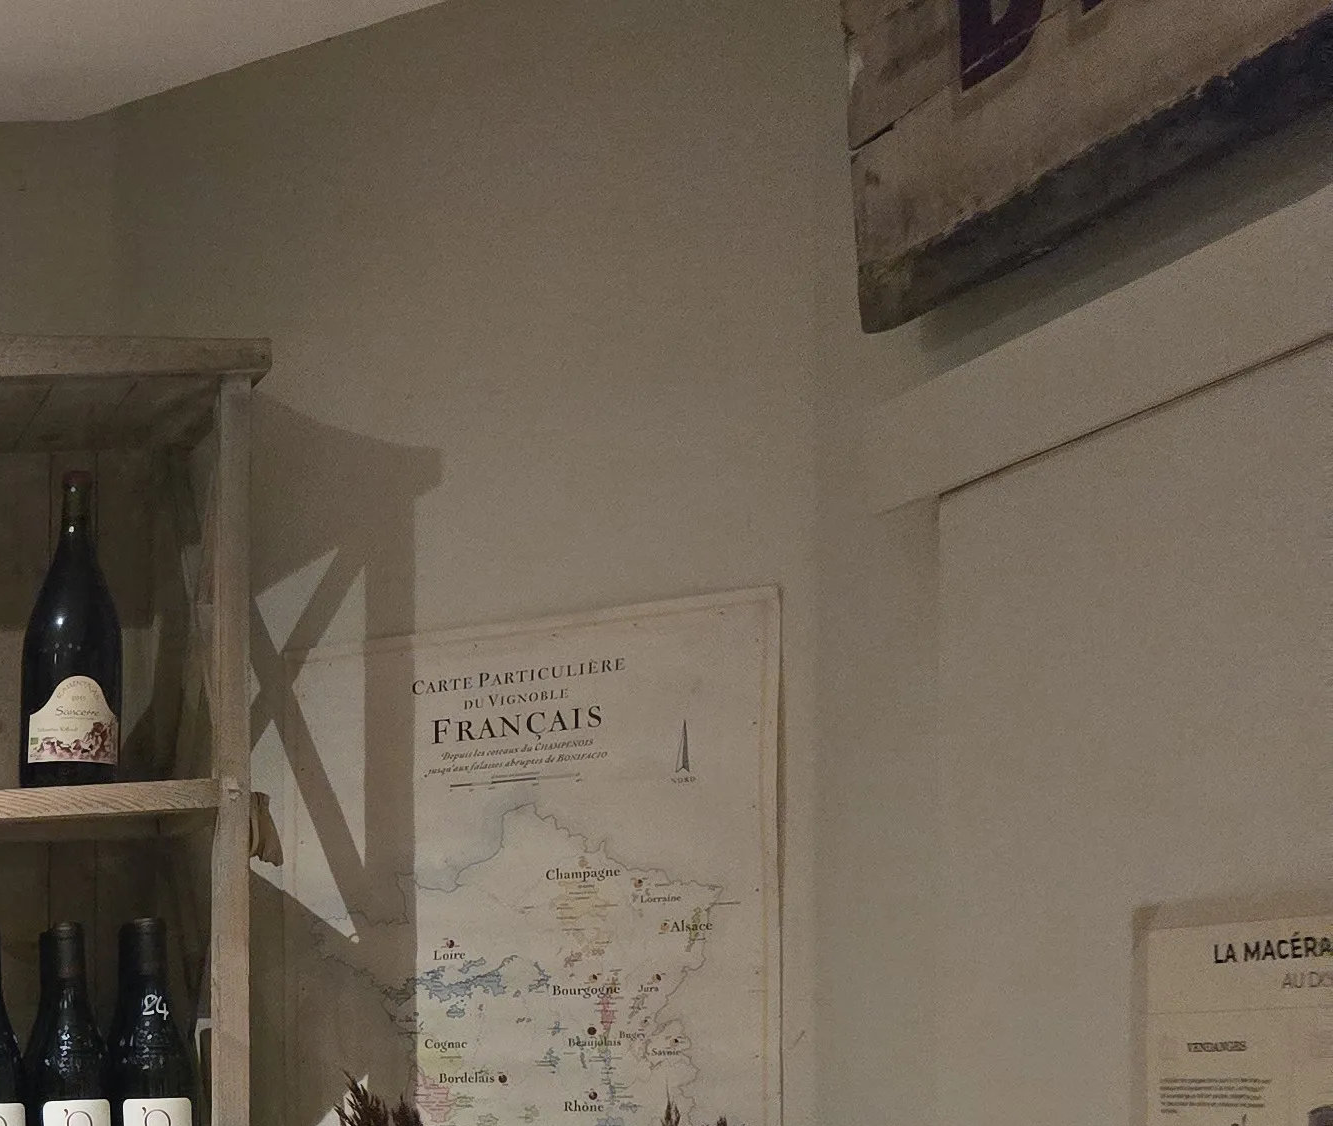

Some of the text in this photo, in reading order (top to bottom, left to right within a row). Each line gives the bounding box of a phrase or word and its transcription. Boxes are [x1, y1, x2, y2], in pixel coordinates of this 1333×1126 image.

[412, 657, 626, 696] CARTE PARTICULIÈRE
[488, 688, 570, 707] VIGNOBLE
[55, 706, 100, 717] Sancerre
[431, 705, 603, 745] FRANÇAIS
[557, 750, 608, 763] BONIFACIO
[671, 776, 696, 784] NORD
[546, 867, 621, 883] Champagne
[640, 894, 681, 904] Lorraine
[671, 920, 713, 933] Alsace
[434, 950, 466, 960] Loire
[1214, 943, 1237, 964] LA
[552, 984, 621, 998] Bourgogne
[638, 984, 659, 993] Jura
[142, 994, 169, 1021] 24
[619, 1031, 646, 1040] Bugey
[425, 1039, 468, 1052] Cognac
[568, 1037, 621, 1049] Beaujolais
[439, 1073, 495, 1084] Bordelais
[564, 1101, 604, 1112] Rhône
